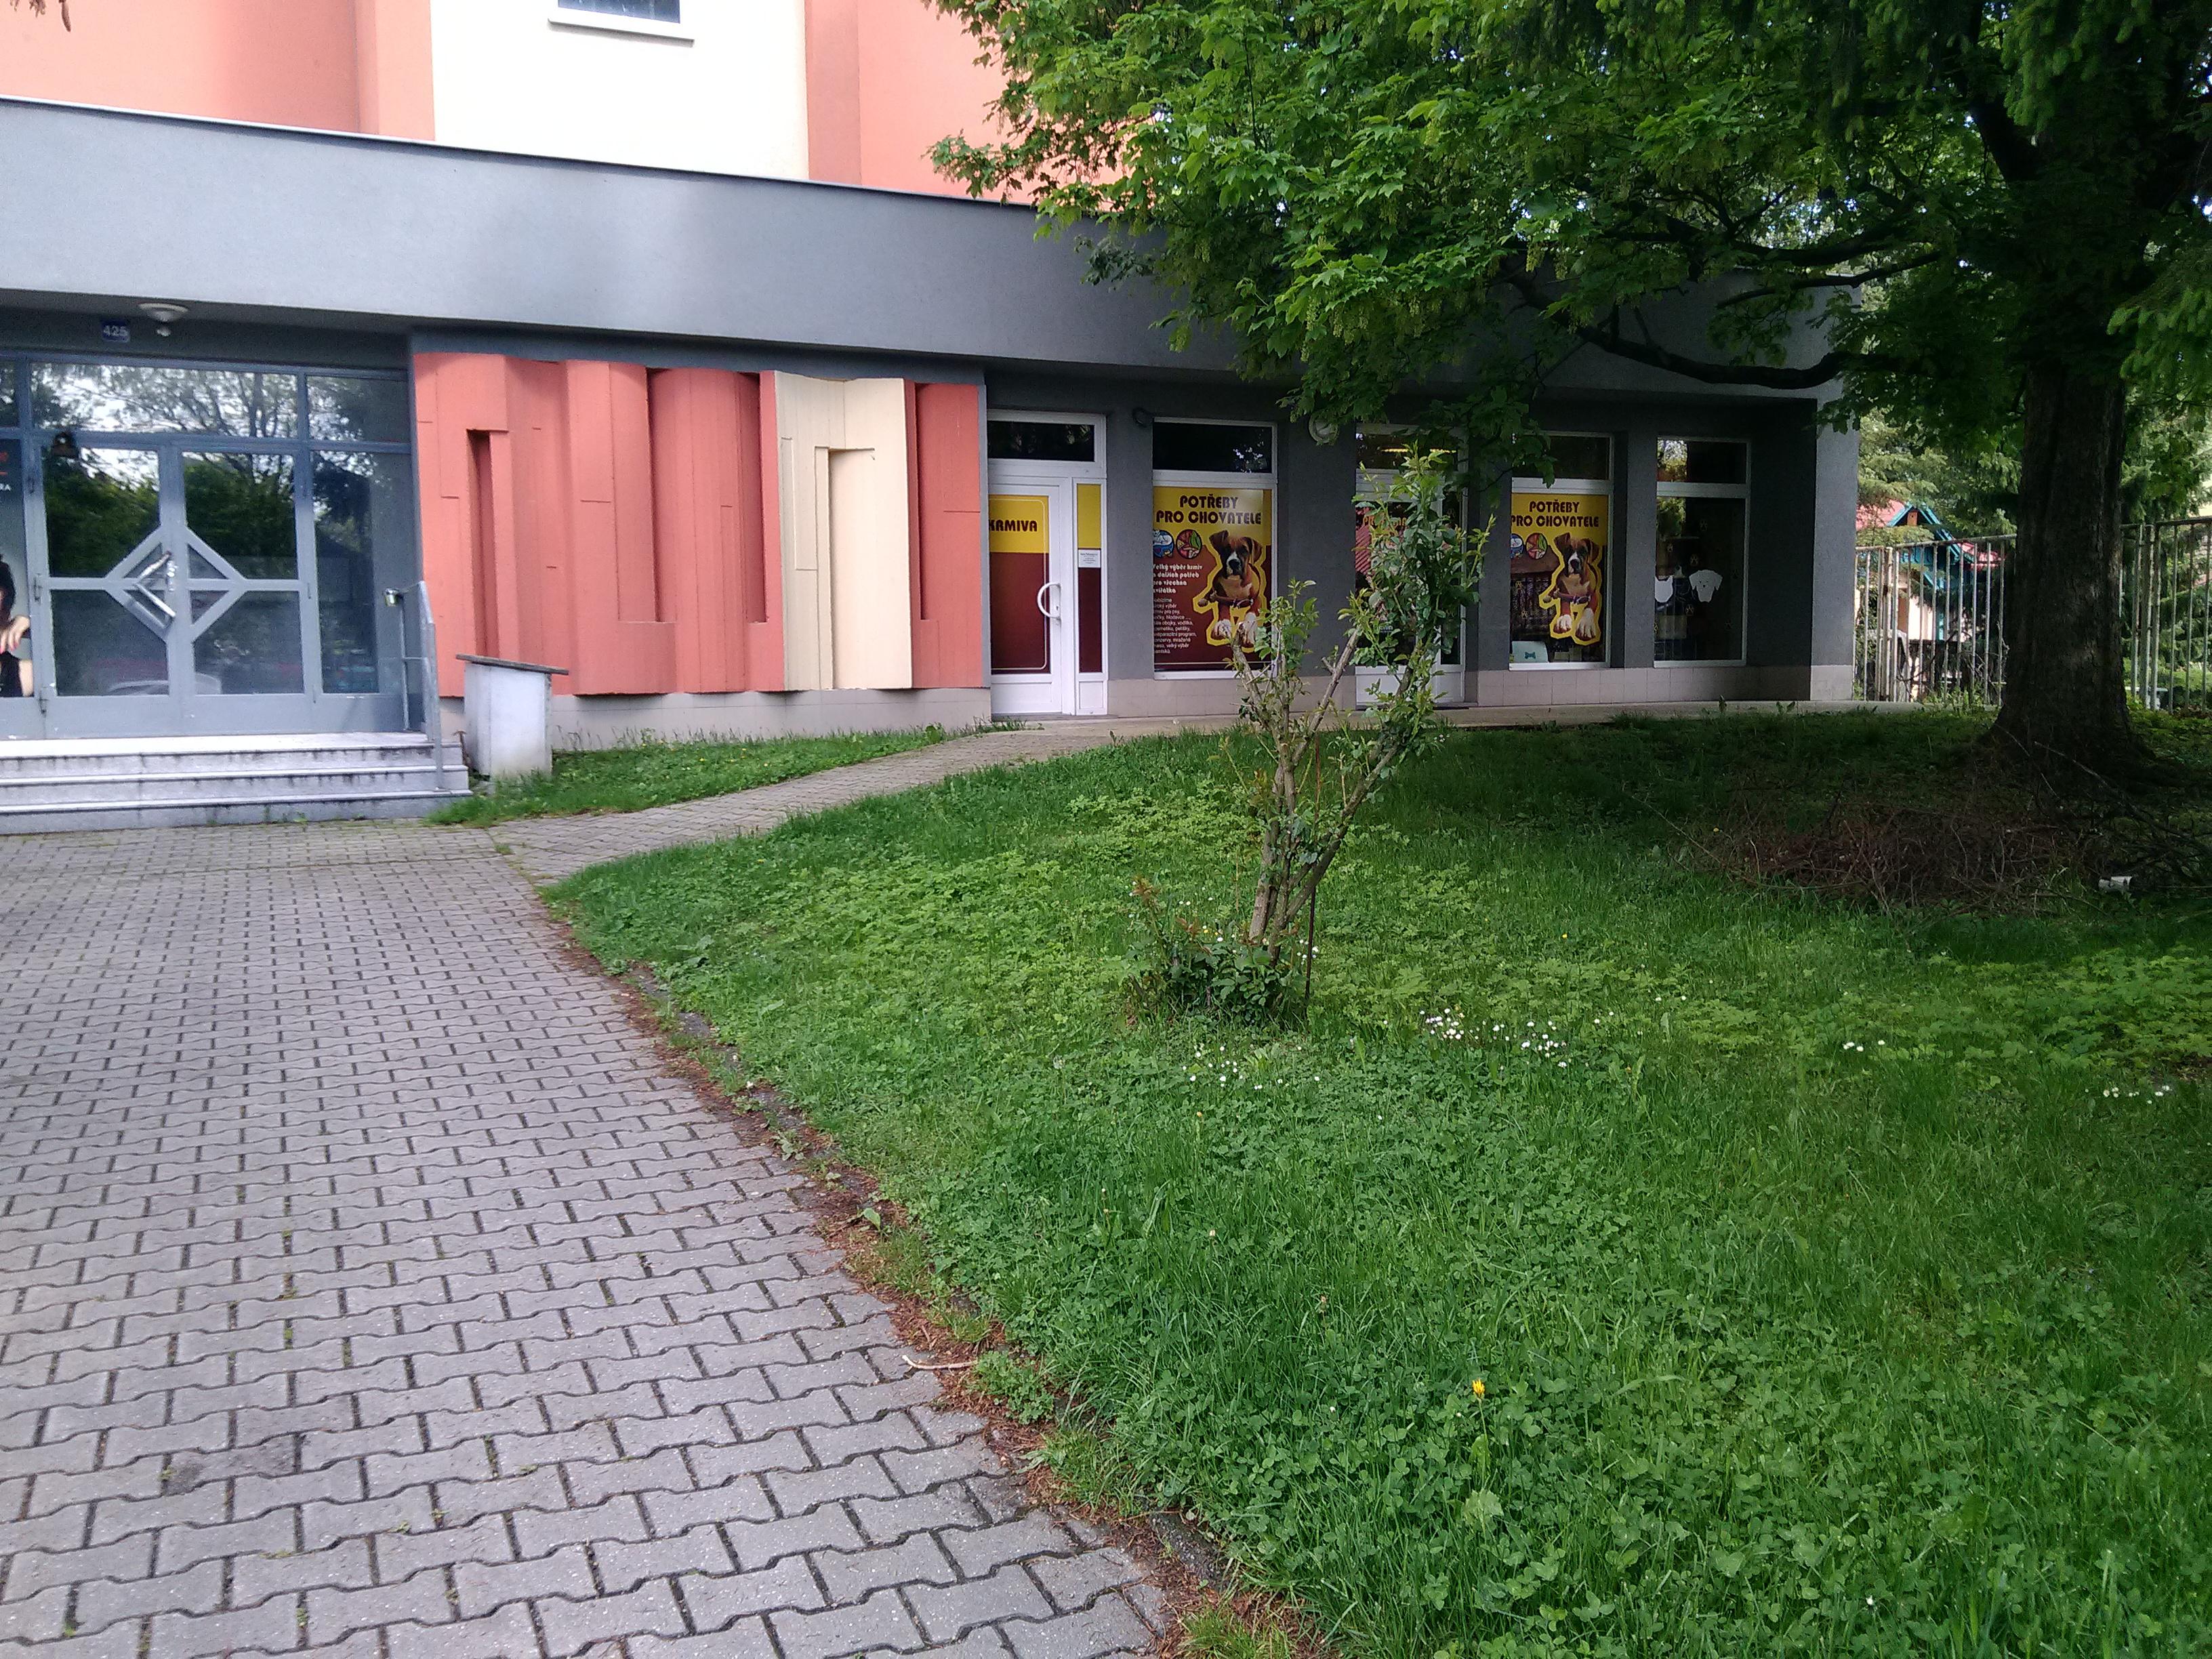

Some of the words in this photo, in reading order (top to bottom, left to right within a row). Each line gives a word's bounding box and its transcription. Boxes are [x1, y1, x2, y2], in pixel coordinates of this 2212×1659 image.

[103, 325, 128, 336] 425
[1180, 494, 1238, 508] POTŘEBY
[1529, 499, 1580, 513] POTŘEBY
[1156, 510, 1184, 523] PRO
[1188, 511, 1261, 525] CHOVATELE
[1511, 515, 1533, 527] PRO
[1536, 515, 1599, 527] CHOVATELE
